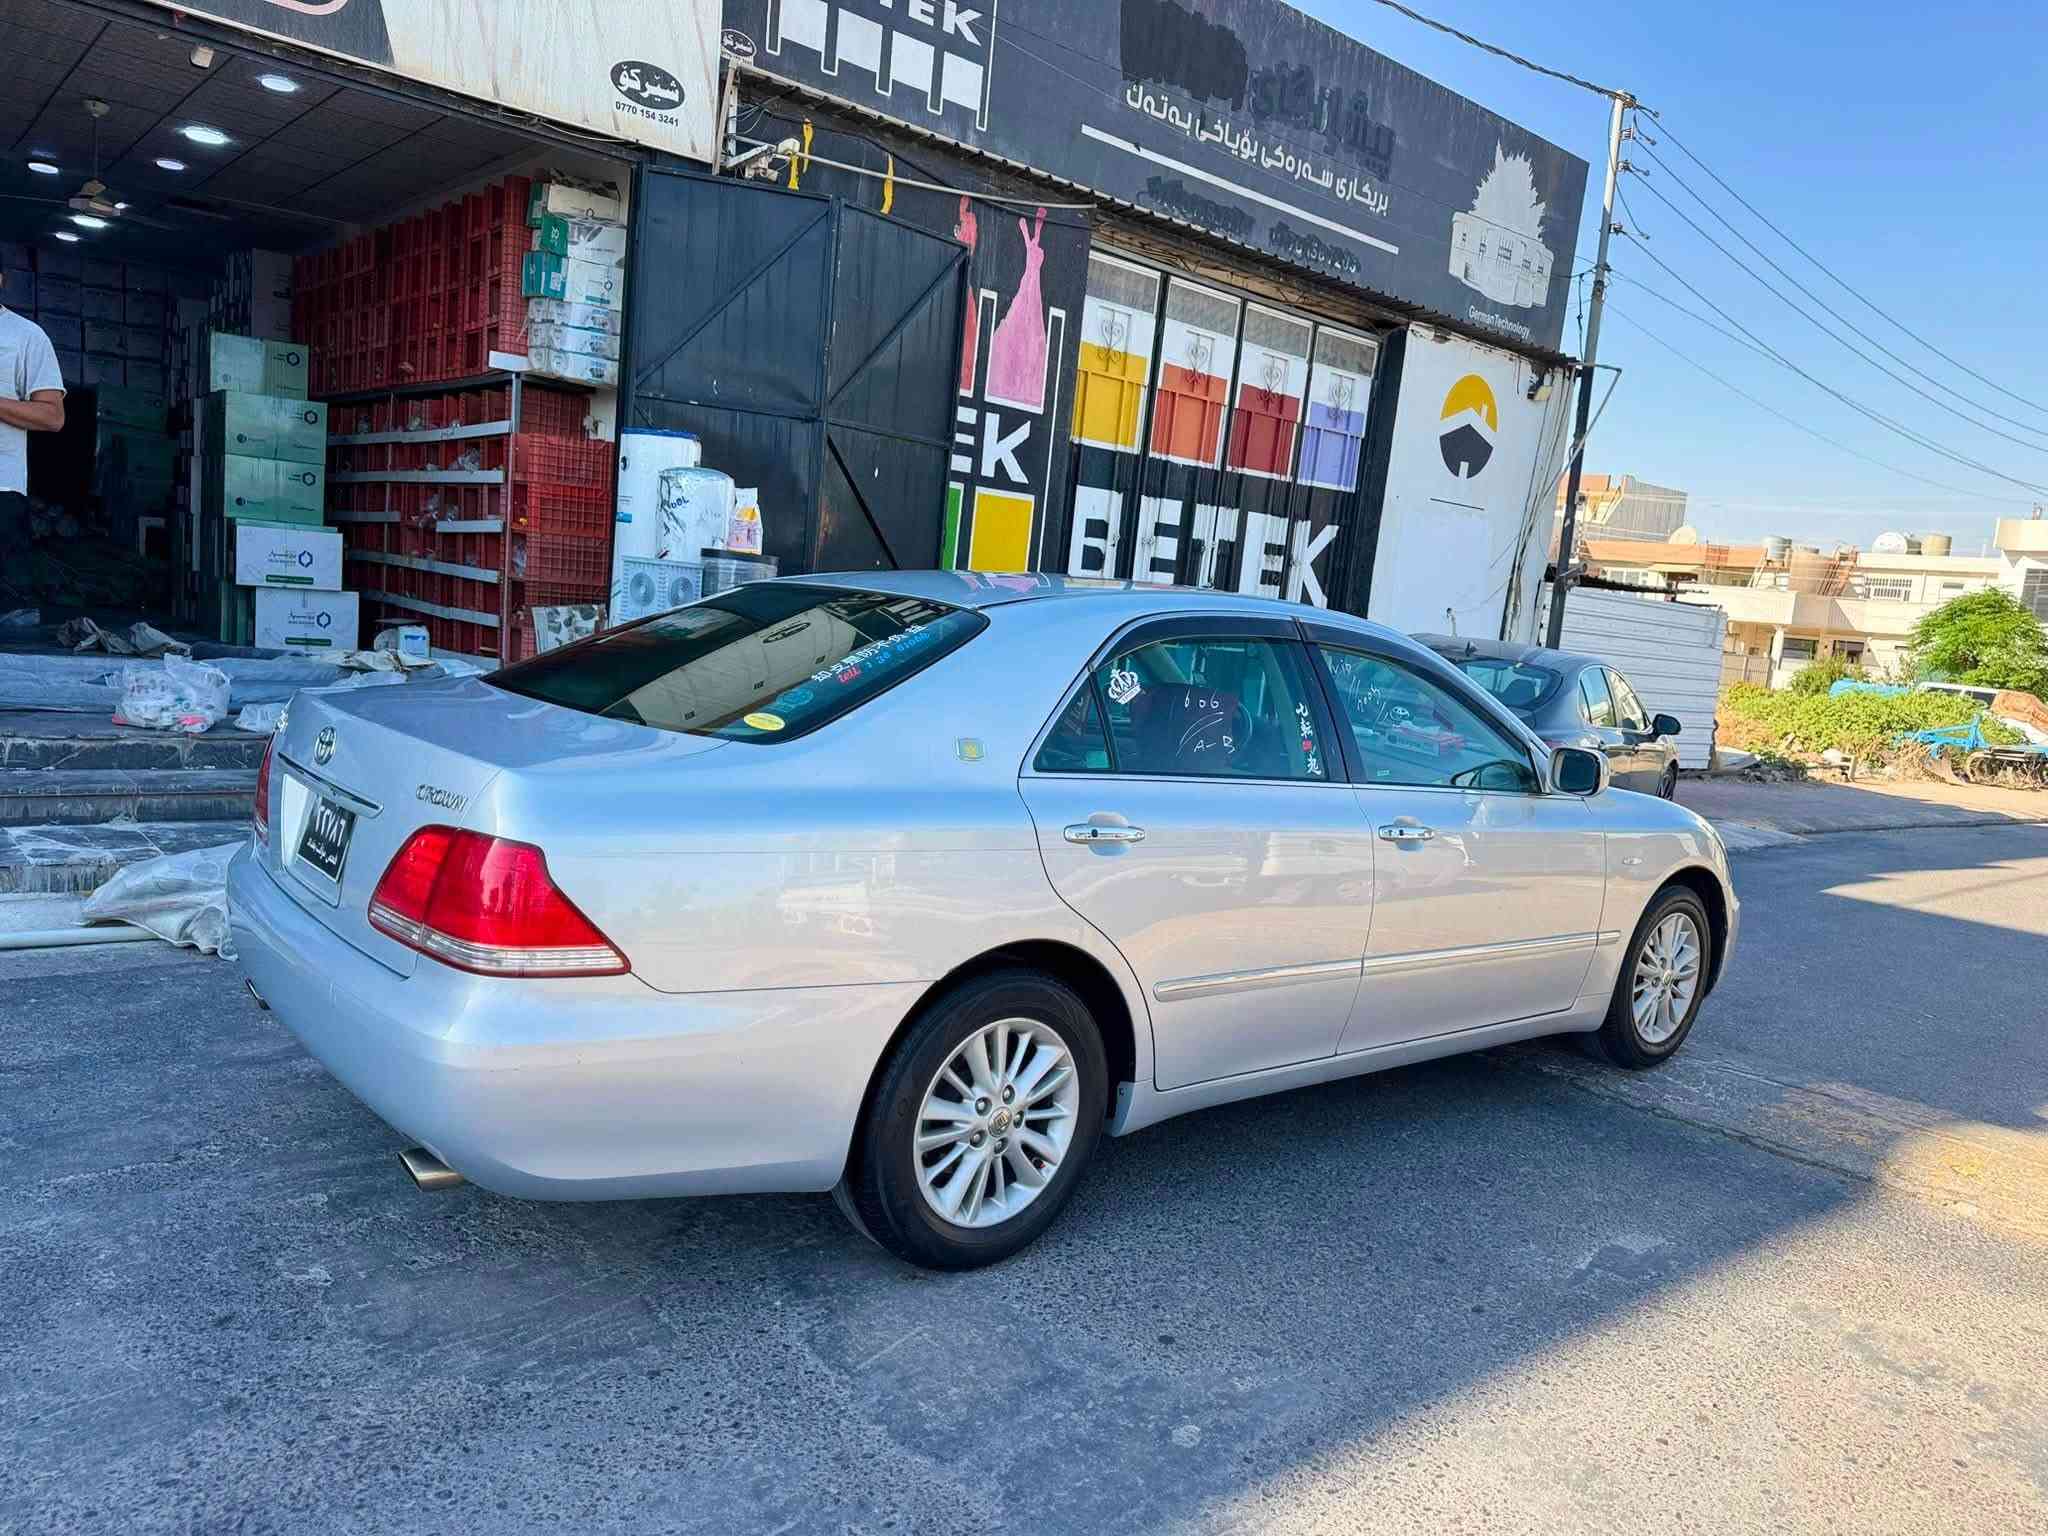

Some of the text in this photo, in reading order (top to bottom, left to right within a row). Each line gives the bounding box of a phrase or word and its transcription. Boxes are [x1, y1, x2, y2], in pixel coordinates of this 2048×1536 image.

[880, 0, 984, 47] EK
[615, 101, 679, 127] 0770 154 3241
[1068, 485, 1339, 609] BETEK
[416, 784, 468, 812] CROWN
